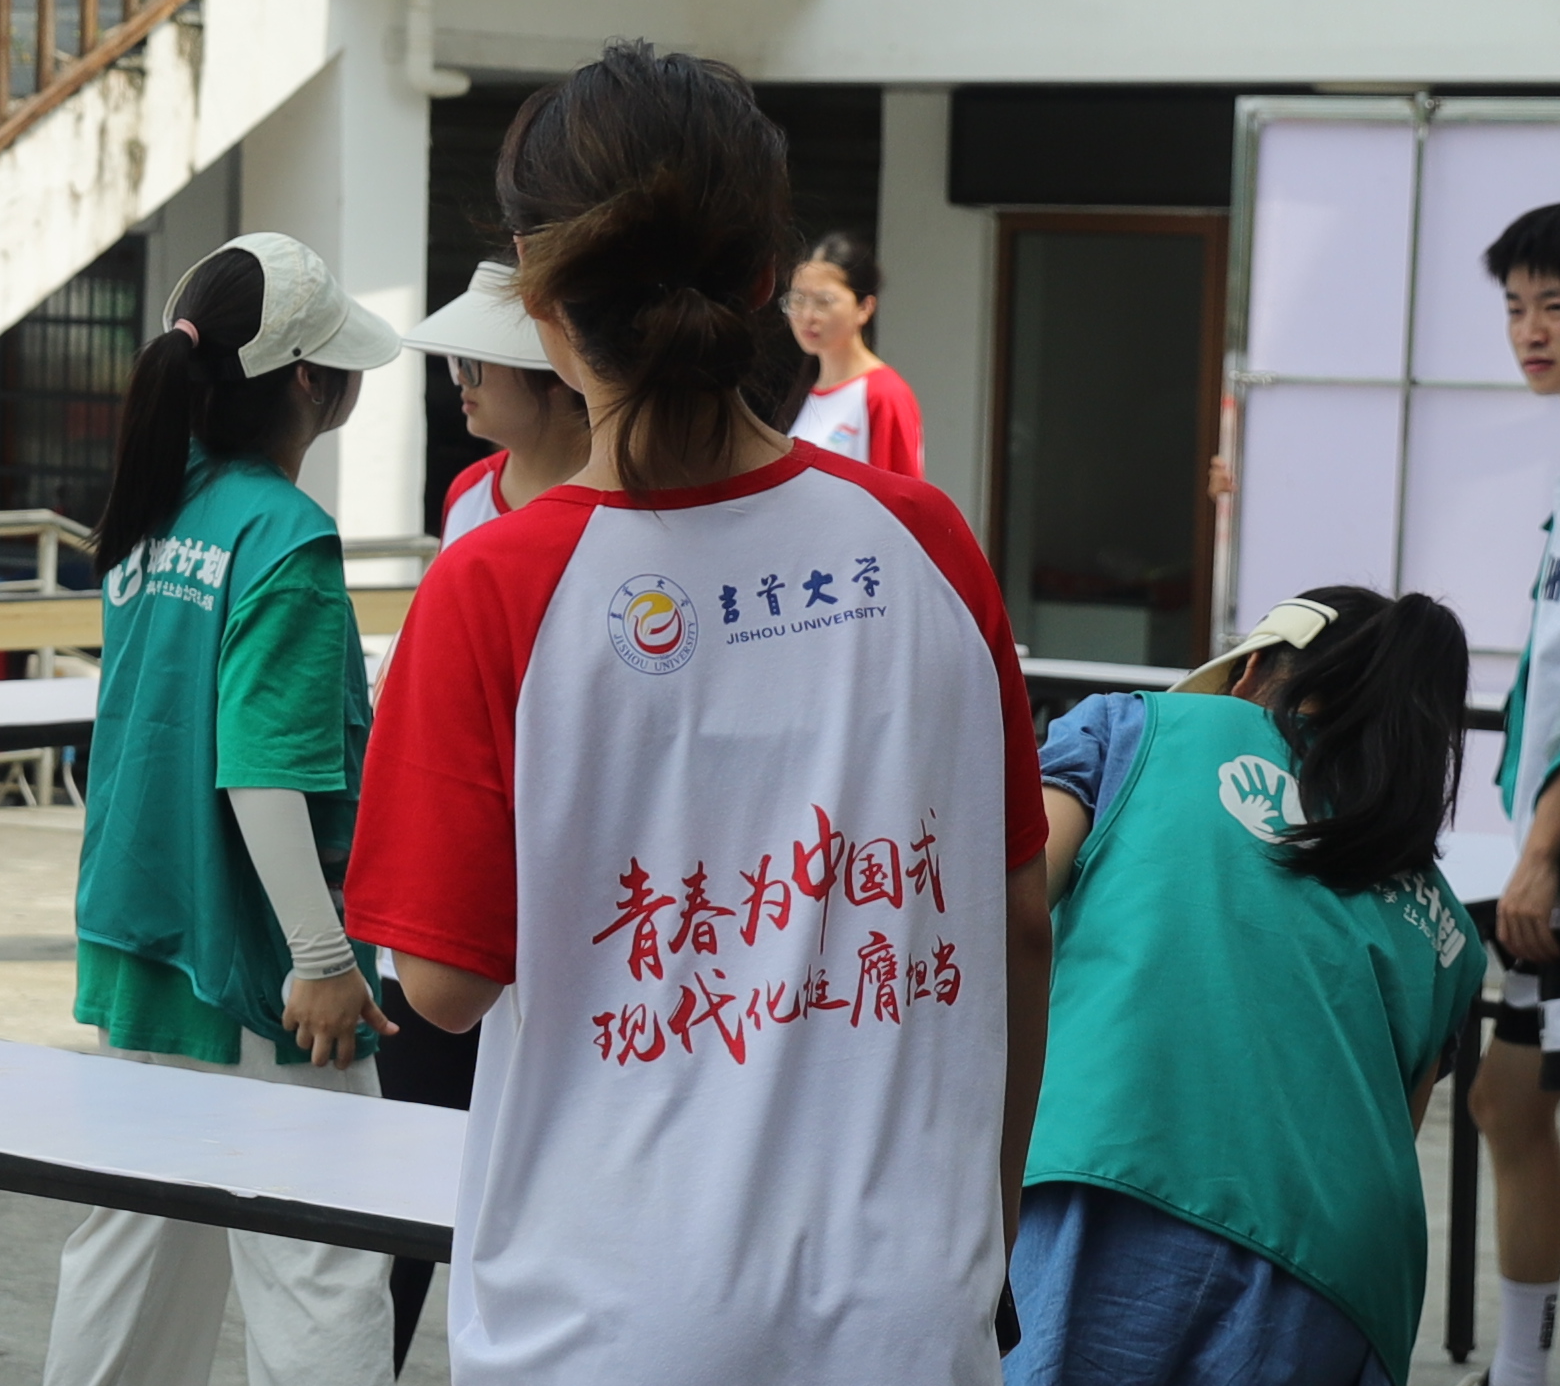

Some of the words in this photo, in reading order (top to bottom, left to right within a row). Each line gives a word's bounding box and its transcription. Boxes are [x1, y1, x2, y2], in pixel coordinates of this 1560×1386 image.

[718, 556, 881, 625] 吉首大学
[726, 625, 786, 645] JISHOU
[791, 606, 887, 634] UNIVERSITY
[592, 803, 946, 983] 青春为中国式
[592, 930, 962, 1066] 现代化挺膺担当
